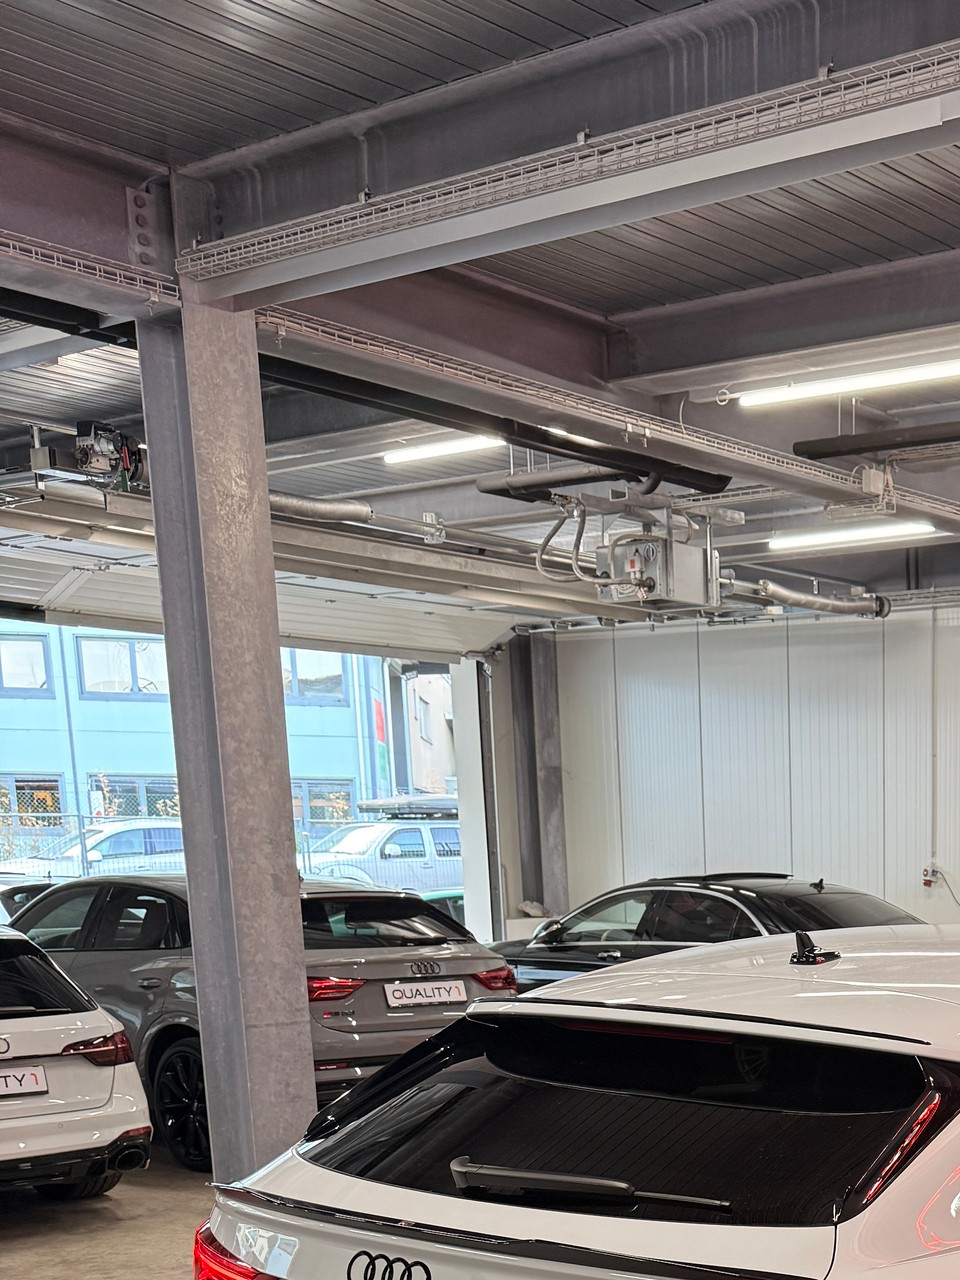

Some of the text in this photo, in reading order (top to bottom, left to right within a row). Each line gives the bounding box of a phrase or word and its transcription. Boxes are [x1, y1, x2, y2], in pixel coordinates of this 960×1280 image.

[392, 985, 462, 1000] QUALITY 1
[30, 1072, 39, 1085] 1
